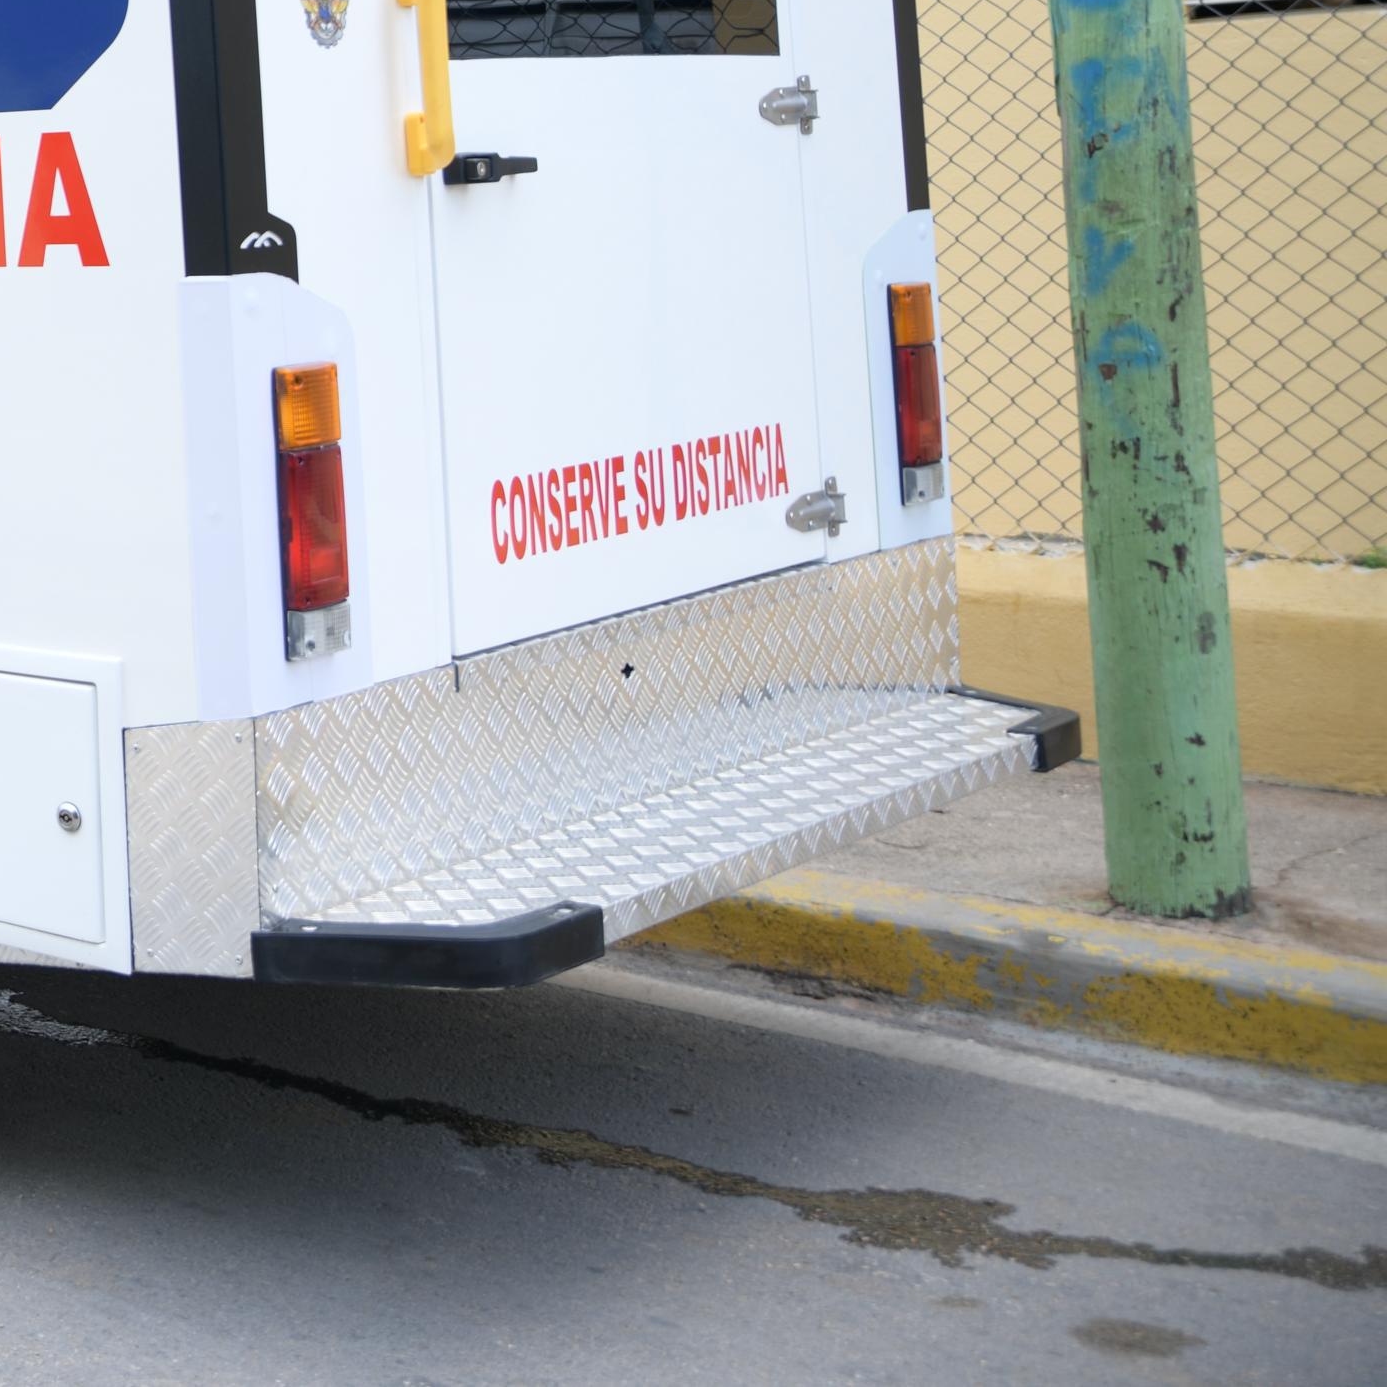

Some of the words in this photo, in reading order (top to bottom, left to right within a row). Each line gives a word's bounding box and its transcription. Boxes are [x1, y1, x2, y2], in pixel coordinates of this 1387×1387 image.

[491, 454, 630, 566] CONSERVE
[634, 447, 666, 532] SU
[671, 422, 790, 522] DISTANCIA
